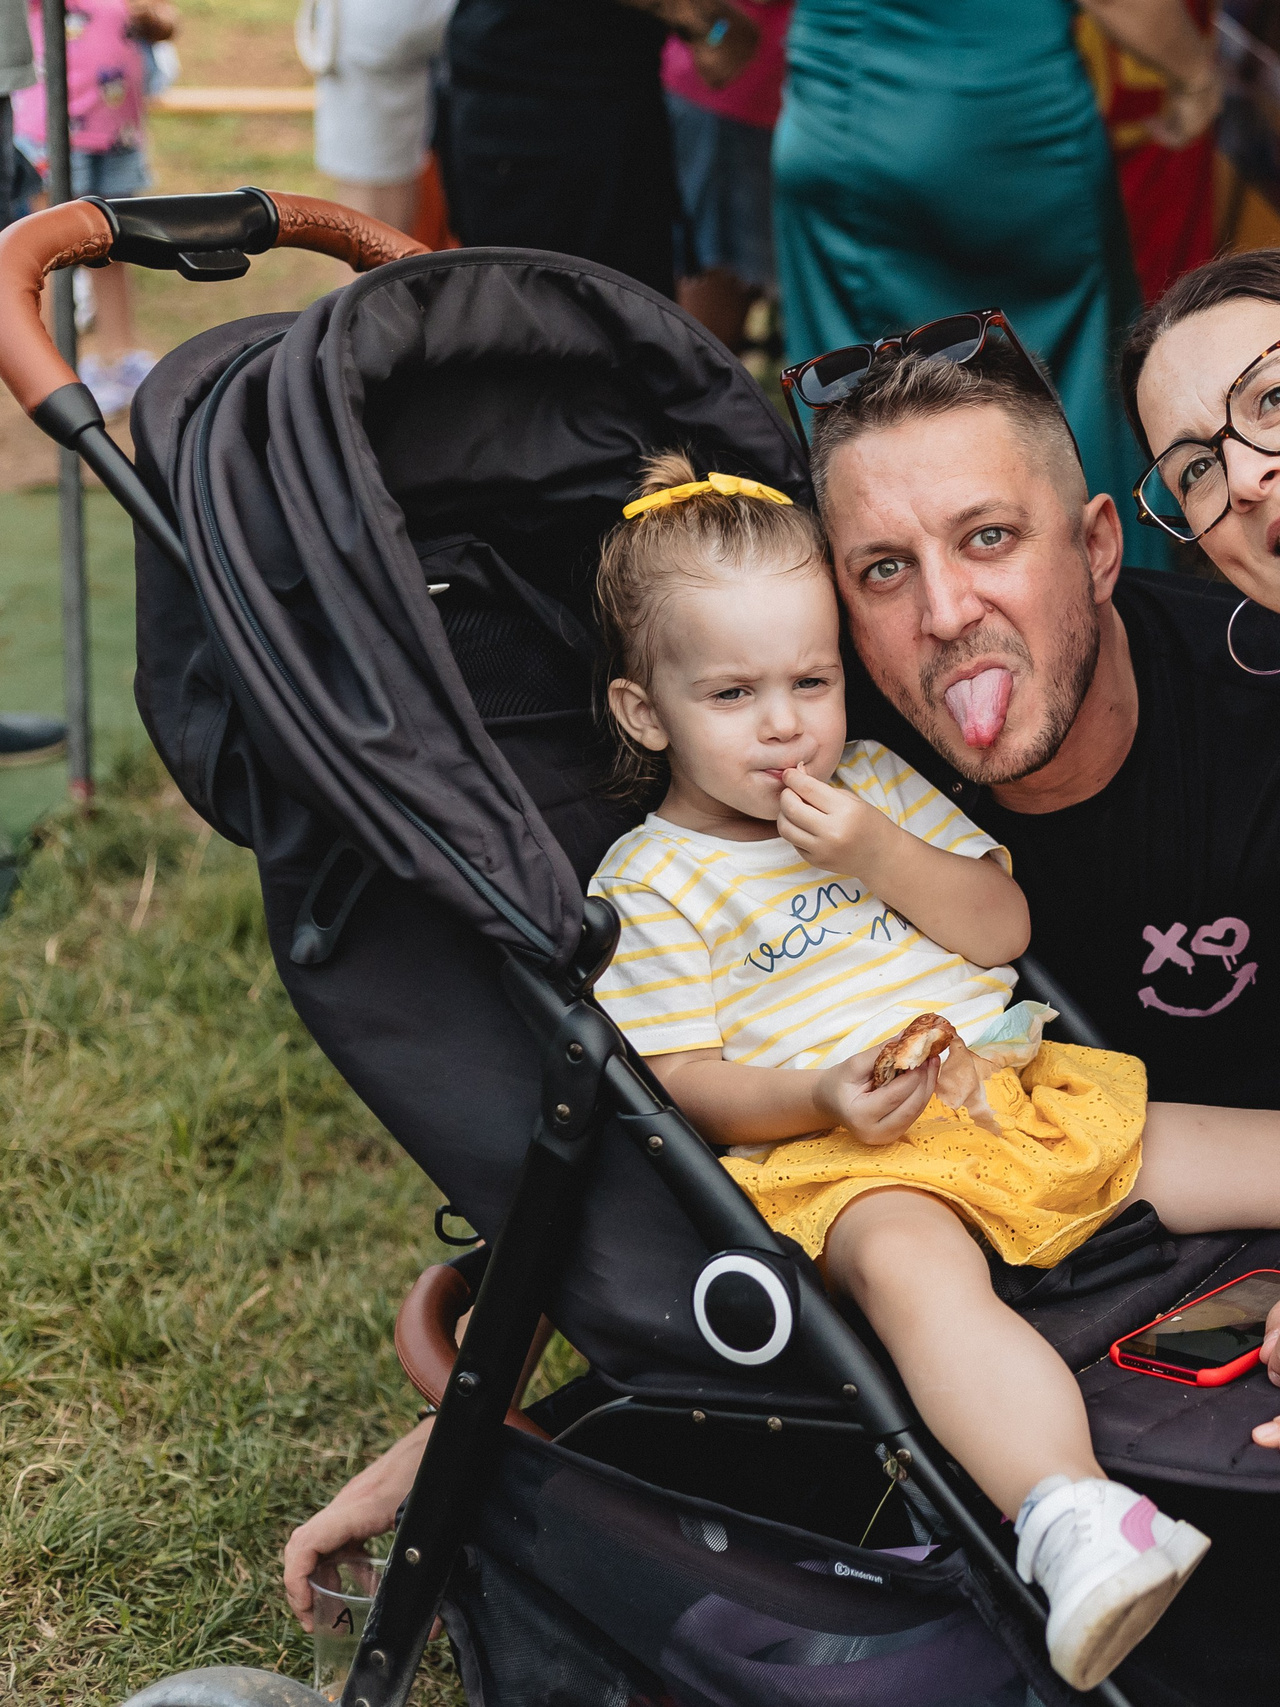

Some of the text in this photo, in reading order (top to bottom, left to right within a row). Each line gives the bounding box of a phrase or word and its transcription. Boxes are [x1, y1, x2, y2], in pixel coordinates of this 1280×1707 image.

[789, 882, 861, 922] en
[850, 1568, 883, 1584] Kinderkraft
[332, 1607, 354, 1634] A
